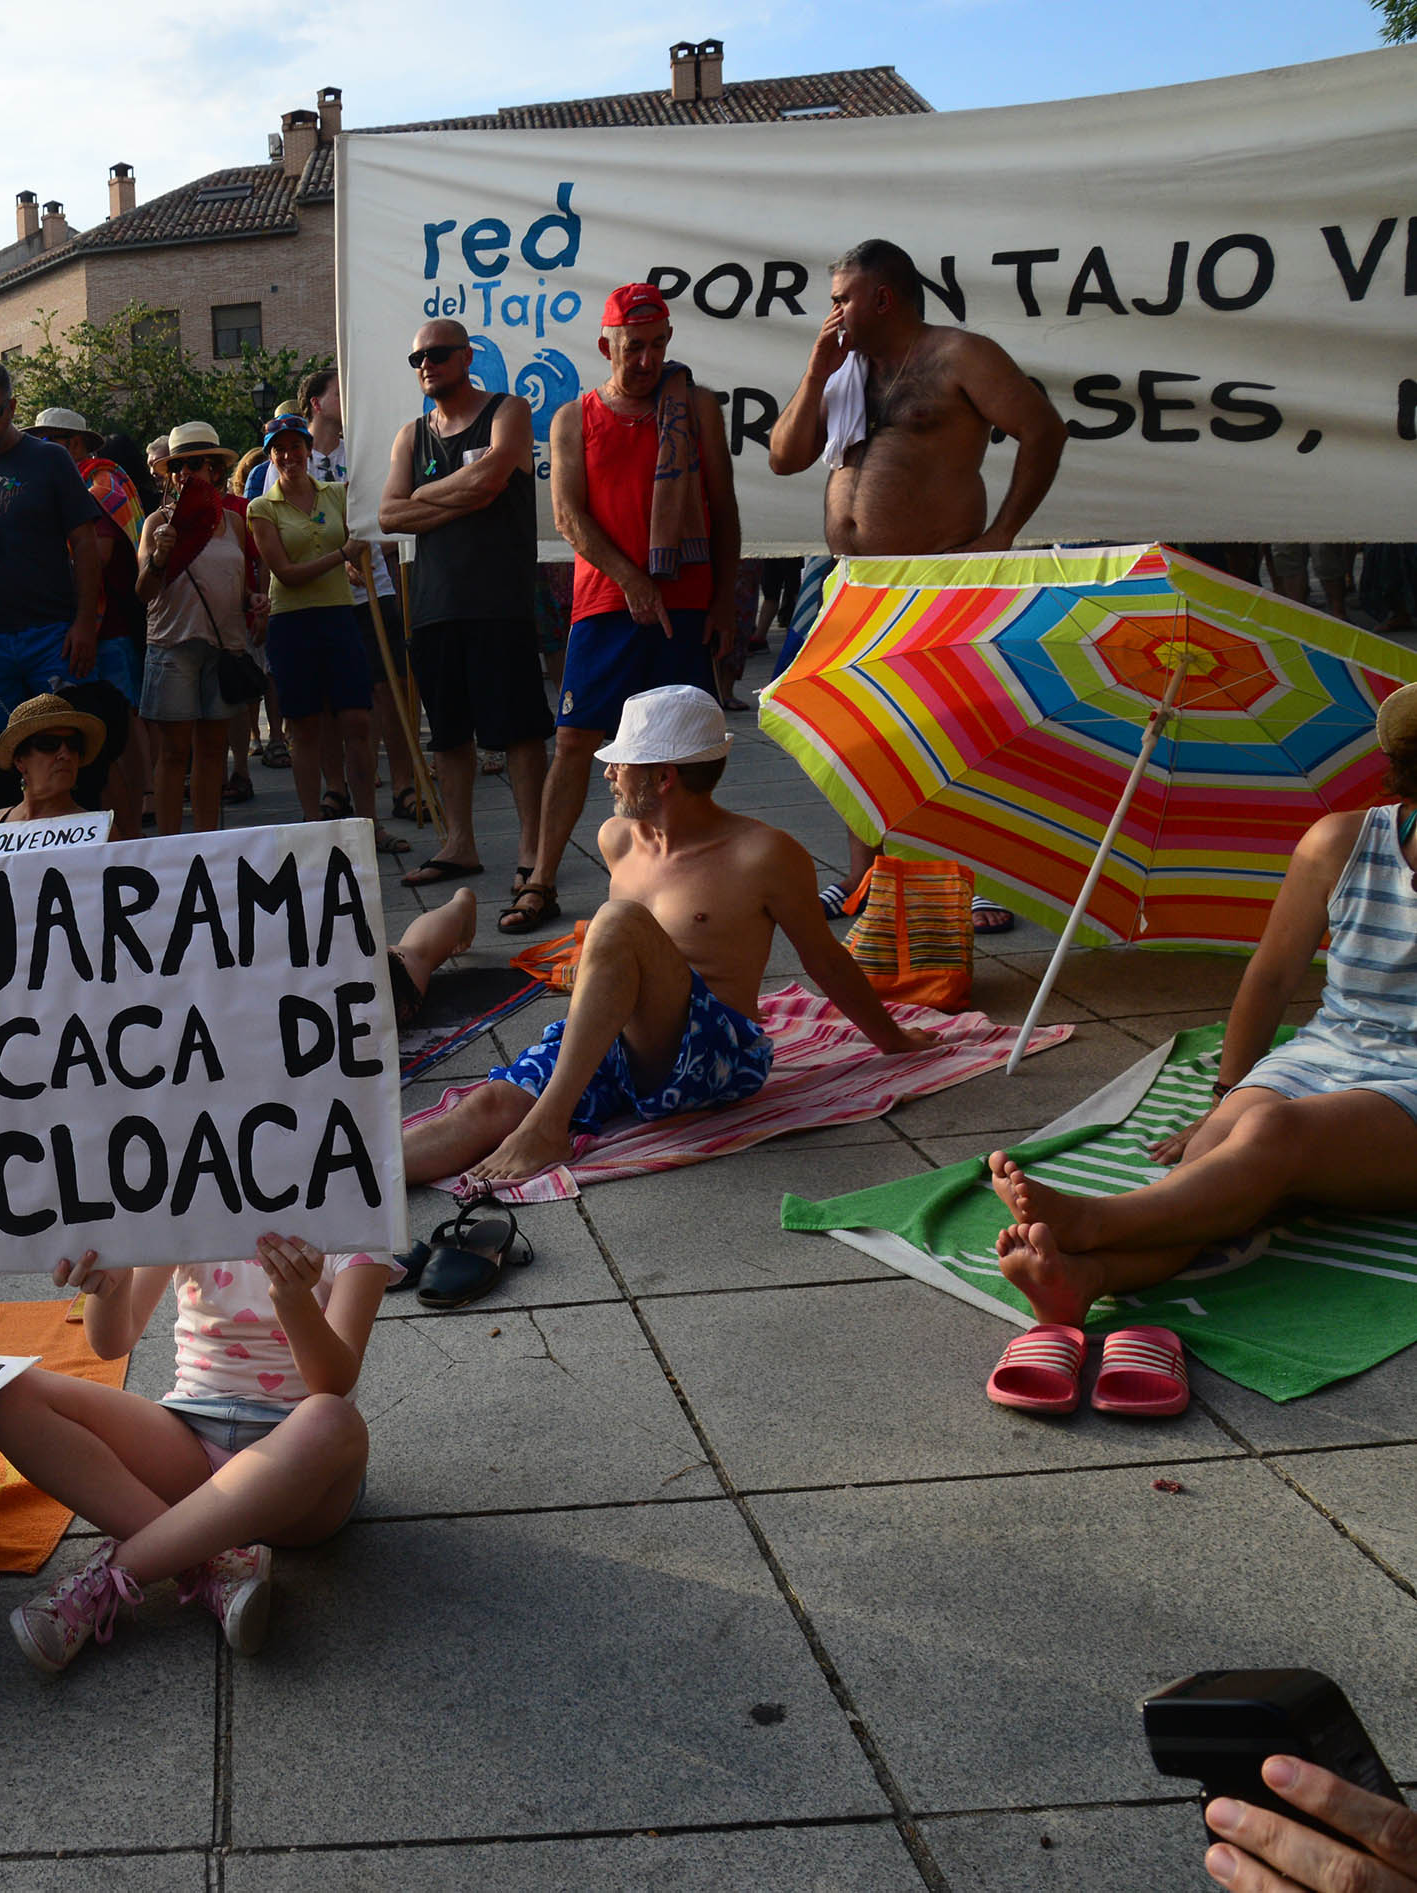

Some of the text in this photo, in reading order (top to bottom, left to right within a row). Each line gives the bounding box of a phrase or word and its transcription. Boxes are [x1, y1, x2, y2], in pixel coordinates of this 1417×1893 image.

[423, 182, 582, 280] red
[648, 261, 808, 319] POR
[991, 233, 1275, 317] TAJO
[423, 278, 582, 338] del Tajo
[279, 981, 384, 1078] DE
